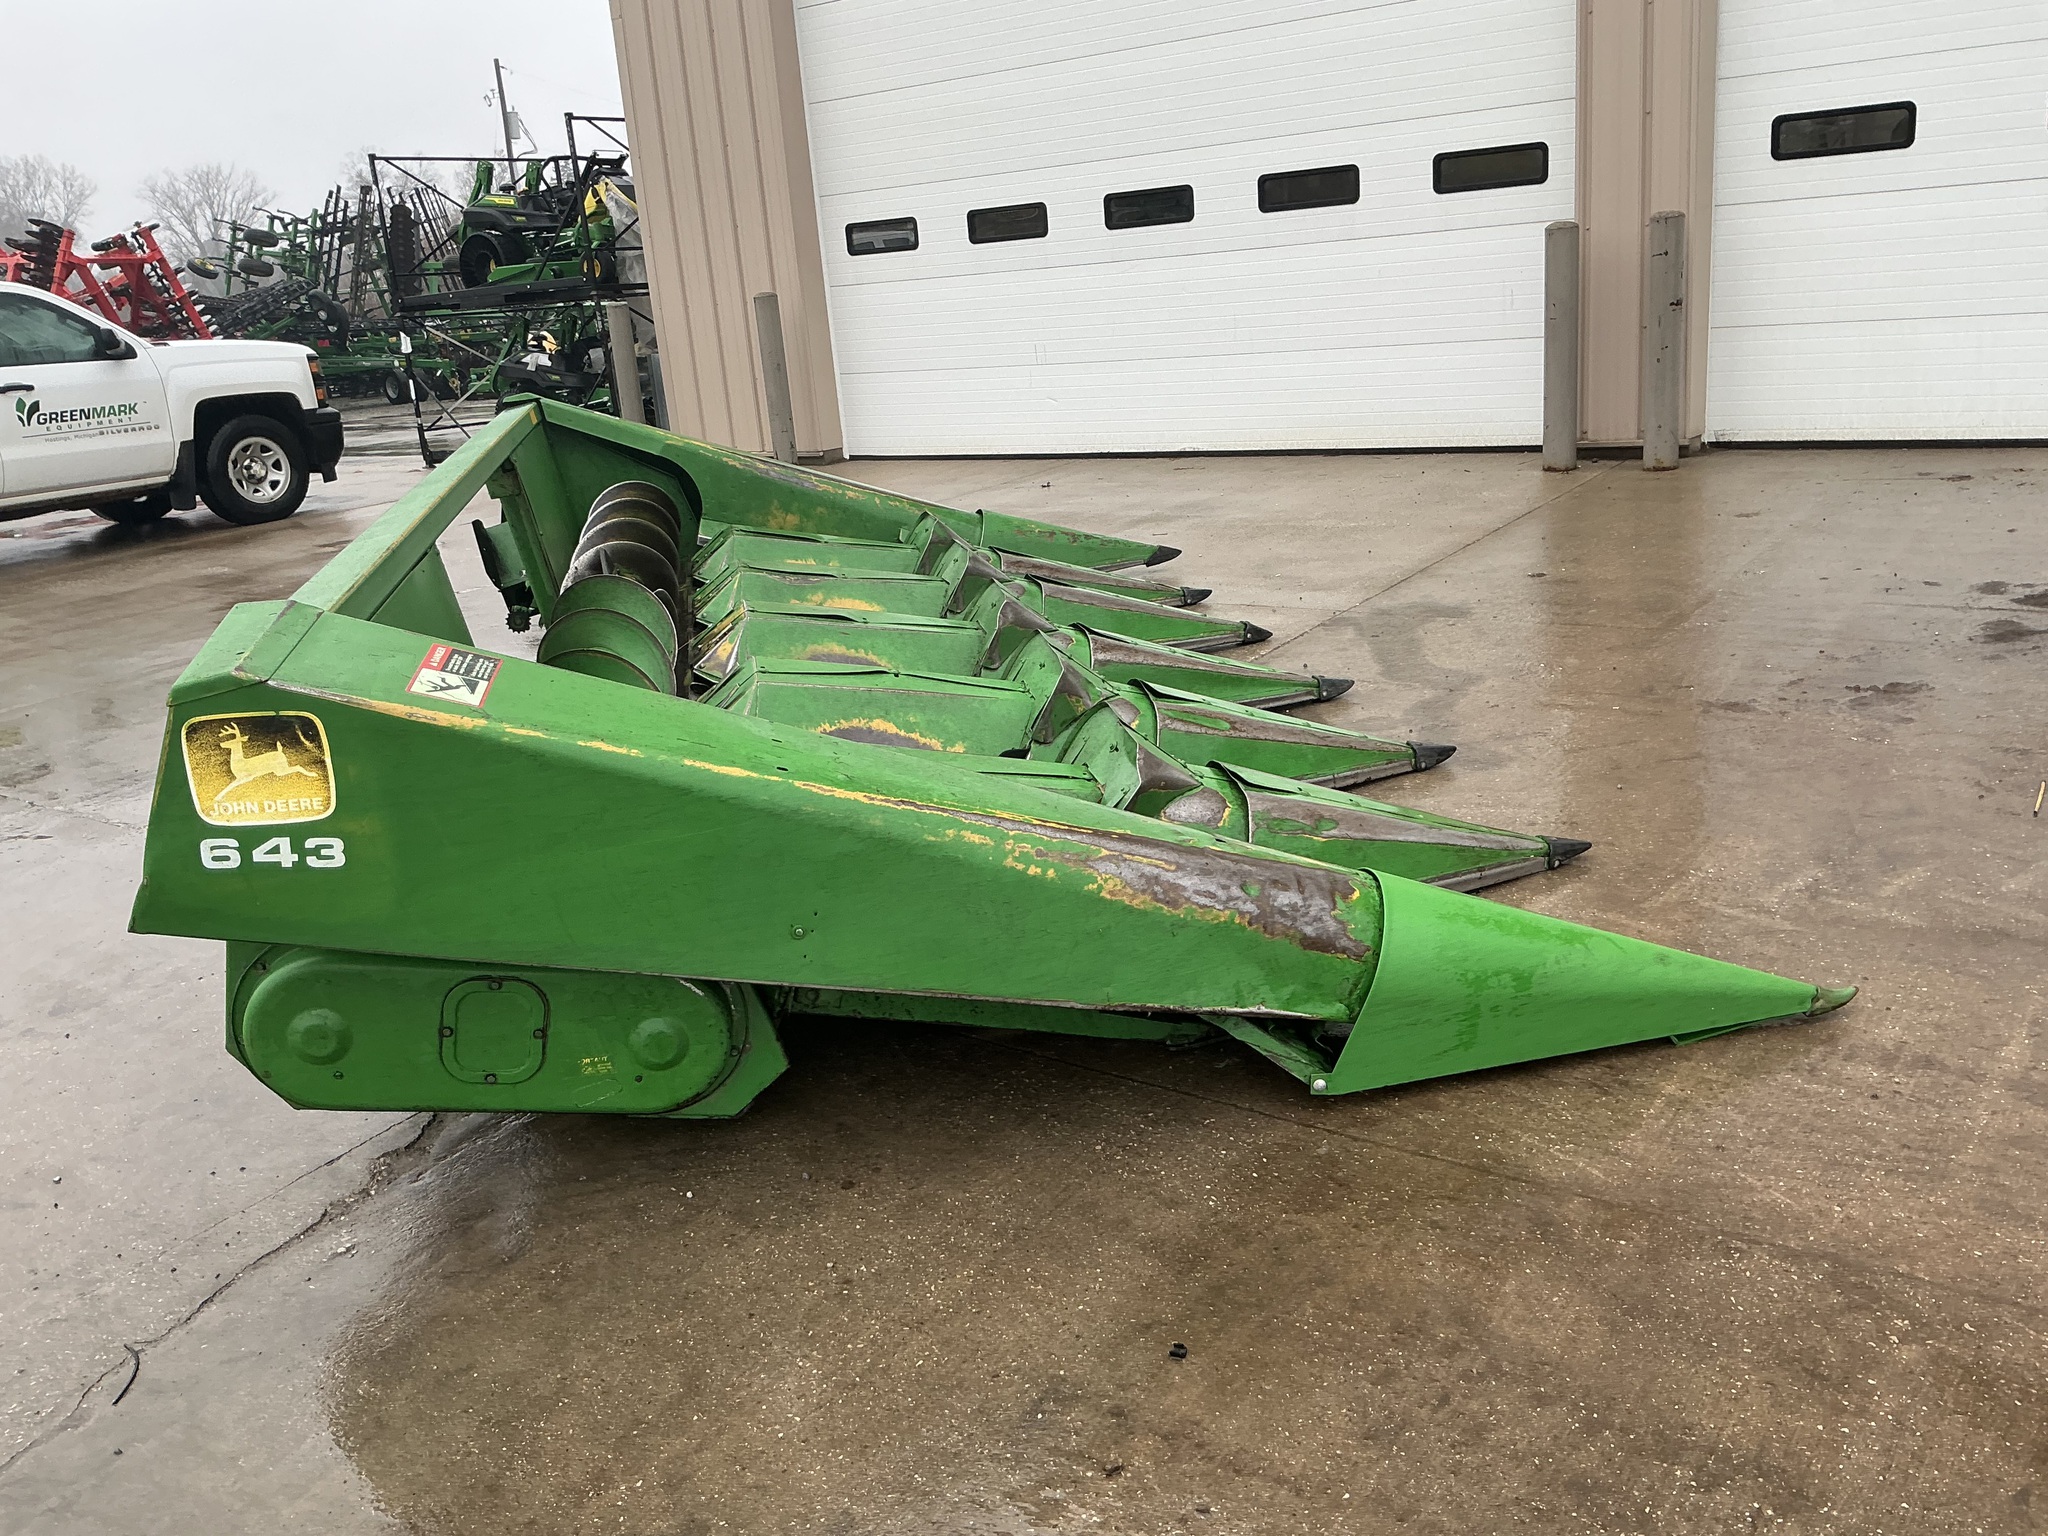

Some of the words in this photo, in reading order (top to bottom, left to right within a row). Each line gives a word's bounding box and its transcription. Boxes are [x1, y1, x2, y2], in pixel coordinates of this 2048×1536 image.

[36, 402, 138, 426] GREENMARK
[46, 416, 133, 432] EQUIPMENT
[98, 424, 161, 436] SILVERADO
[209, 801, 259, 817] JOHN
[264, 797, 324, 813] DEERE
[200, 836, 347, 870] 643
